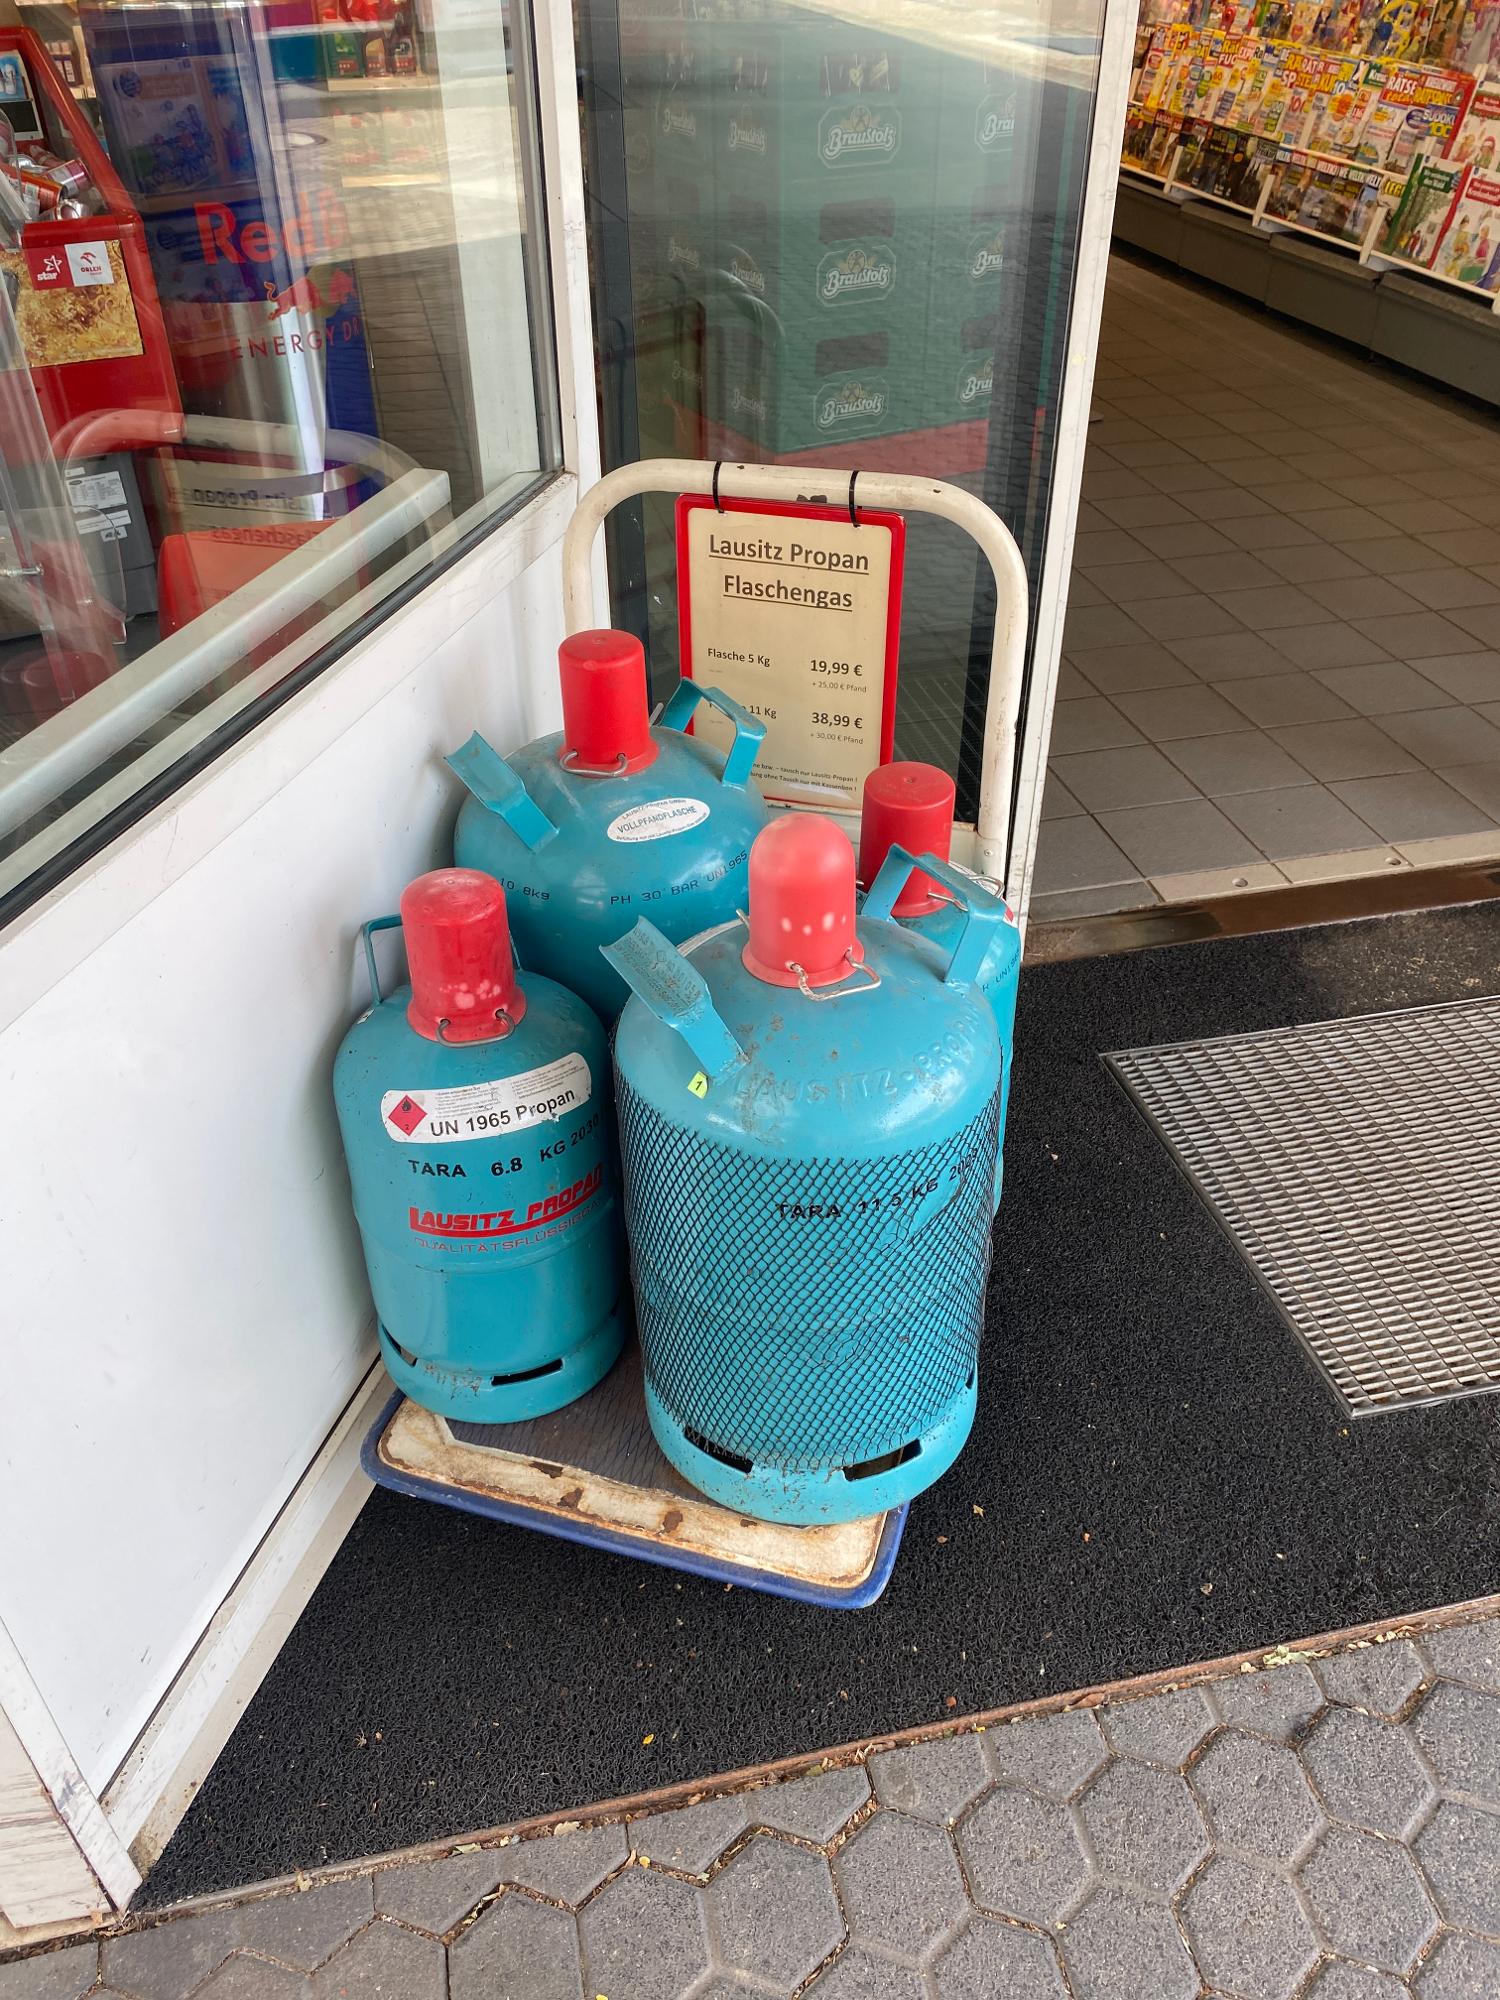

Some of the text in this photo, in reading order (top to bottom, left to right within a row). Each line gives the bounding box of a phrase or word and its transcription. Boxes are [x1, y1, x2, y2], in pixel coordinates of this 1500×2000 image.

[193, 190, 317, 265] Red
[37, 271, 57, 282] star
[231, 326, 338, 360] ENERGY
[709, 534, 869, 571] Lausitz Propan
[724, 574, 853, 609] Flaschengas
[707, 648, 771, 668] Flasche 5 Kg
[810, 659, 863, 677] 19,99 €
[818, 680, 839, 690] 25,00
[846, 684, 867, 694] Pfand
[749, 704, 761, 716] 11
[764, 706, 777, 719] Kg
[811, 711, 863, 729] 38,99 €
[816, 732, 836, 741] 30,00
[843, 735, 864, 745] Pfand
[617, 805, 697, 834] VOLLPFANDFLASCHE
[610, 894, 631, 905] PH
[641, 889, 662, 903] 30
[671, 879, 699, 897] BAR
[695, 1080, 703, 1091] 1
[430, 1119, 458, 1137] UN
[466, 1109, 511, 1132] 1965
[515, 1089, 575, 1123] Propan
[408, 1113, 600, 1178] TARA 6.8 KG 2030
[409, 1162, 604, 1236] LAUSITZ PROPAN
[776, 1203, 842, 1219] TARA
[912, 1177, 938, 1199] KG
